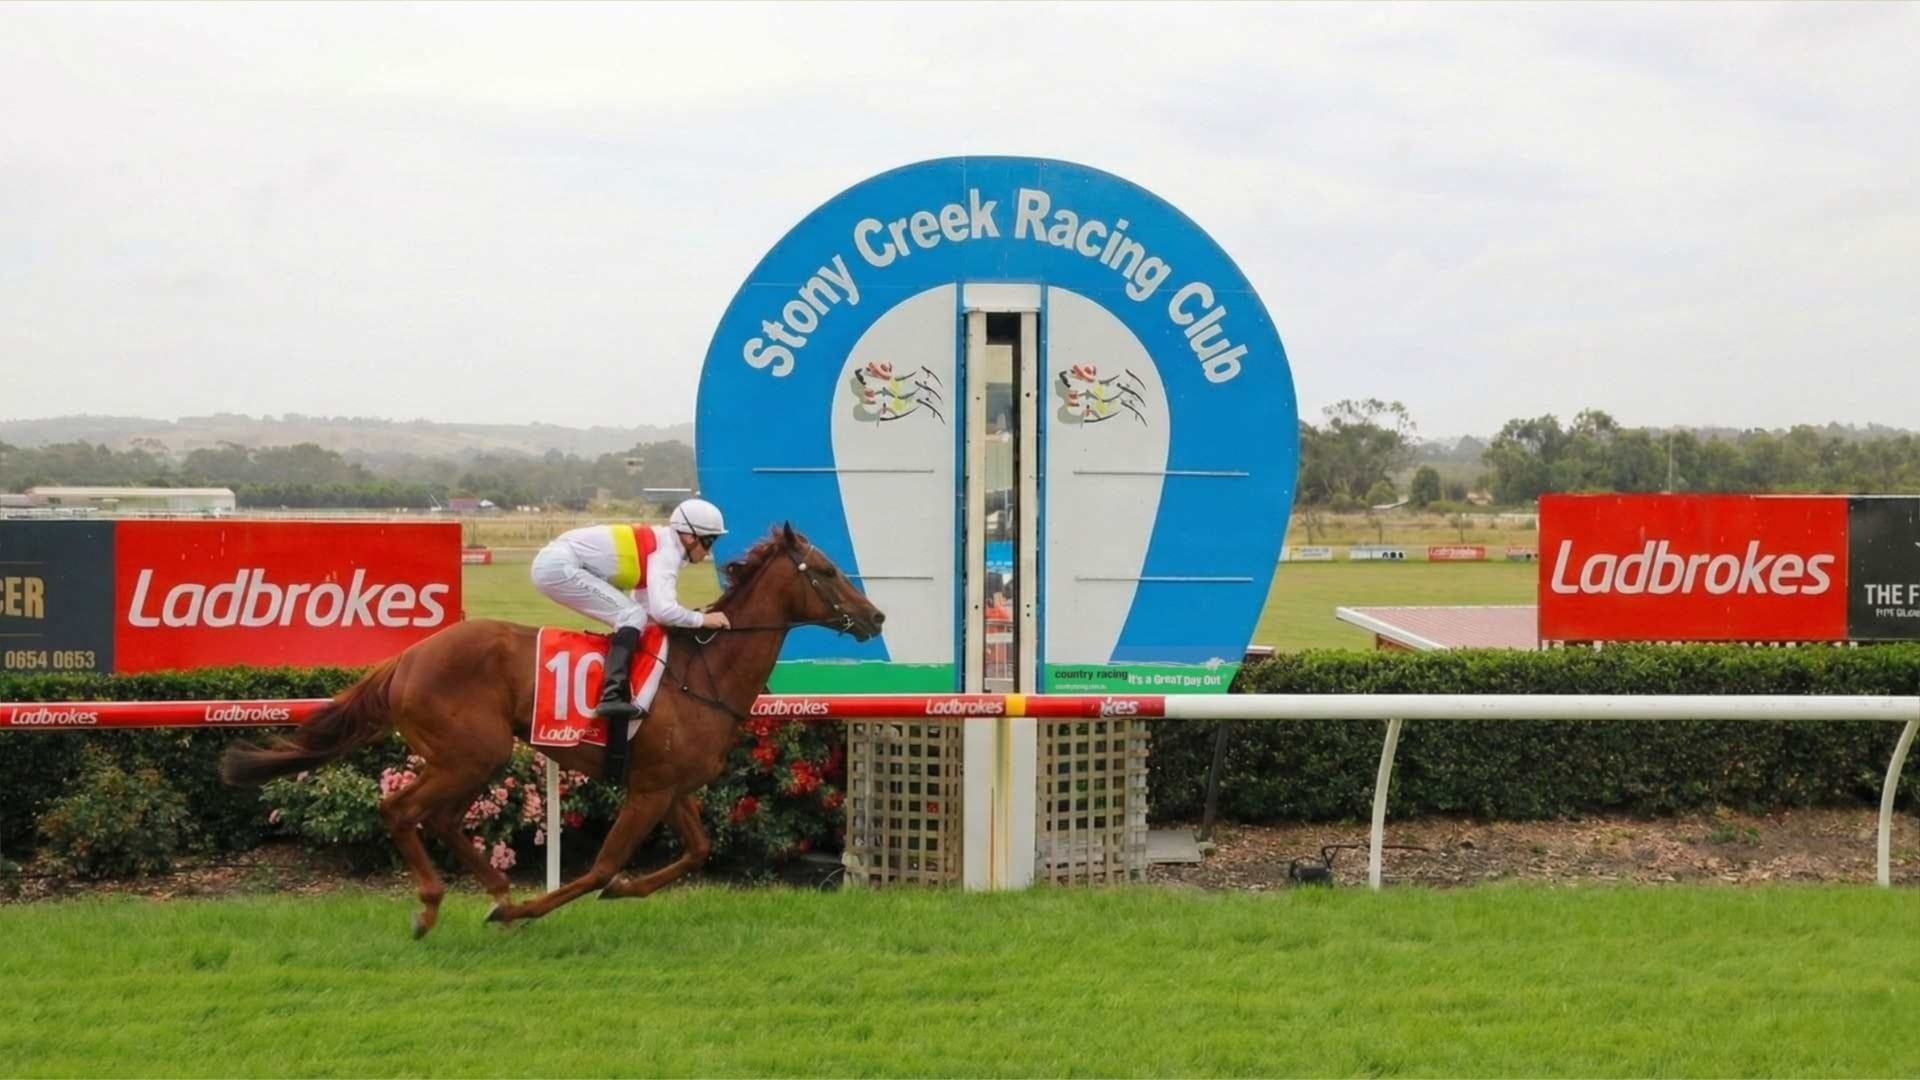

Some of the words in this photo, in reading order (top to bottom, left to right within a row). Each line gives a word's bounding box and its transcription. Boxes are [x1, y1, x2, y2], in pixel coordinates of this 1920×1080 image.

[743, 254, 861, 377] Stony
[854, 188, 999, 268] Creek
[1014, 188, 1171, 302] Racing
[1168, 281, 1248, 384] Club
[1550, 539, 1834, 596] Ladbrokes
[128, 568, 449, 629] Ladbrokes
[1863, 584, 1903, 605] THE
[5, 650, 48, 669] 0654
[53, 650, 96, 669] 0653
[1055, 669, 1094, 681] country
[1096, 669, 1129, 681] racing
[1145, 675, 1152, 685] a
[1183, 676, 1202, 687] Day
[1203, 675, 1222, 686] Out
[545, 650, 606, 721] 10
[204, 705, 290, 722] Ladbrokes
[750, 700, 829, 716] Ladbrokes
[925, 699, 1003, 715] Ladbrokes
[10, 708, 97, 725] Ladbrokes
